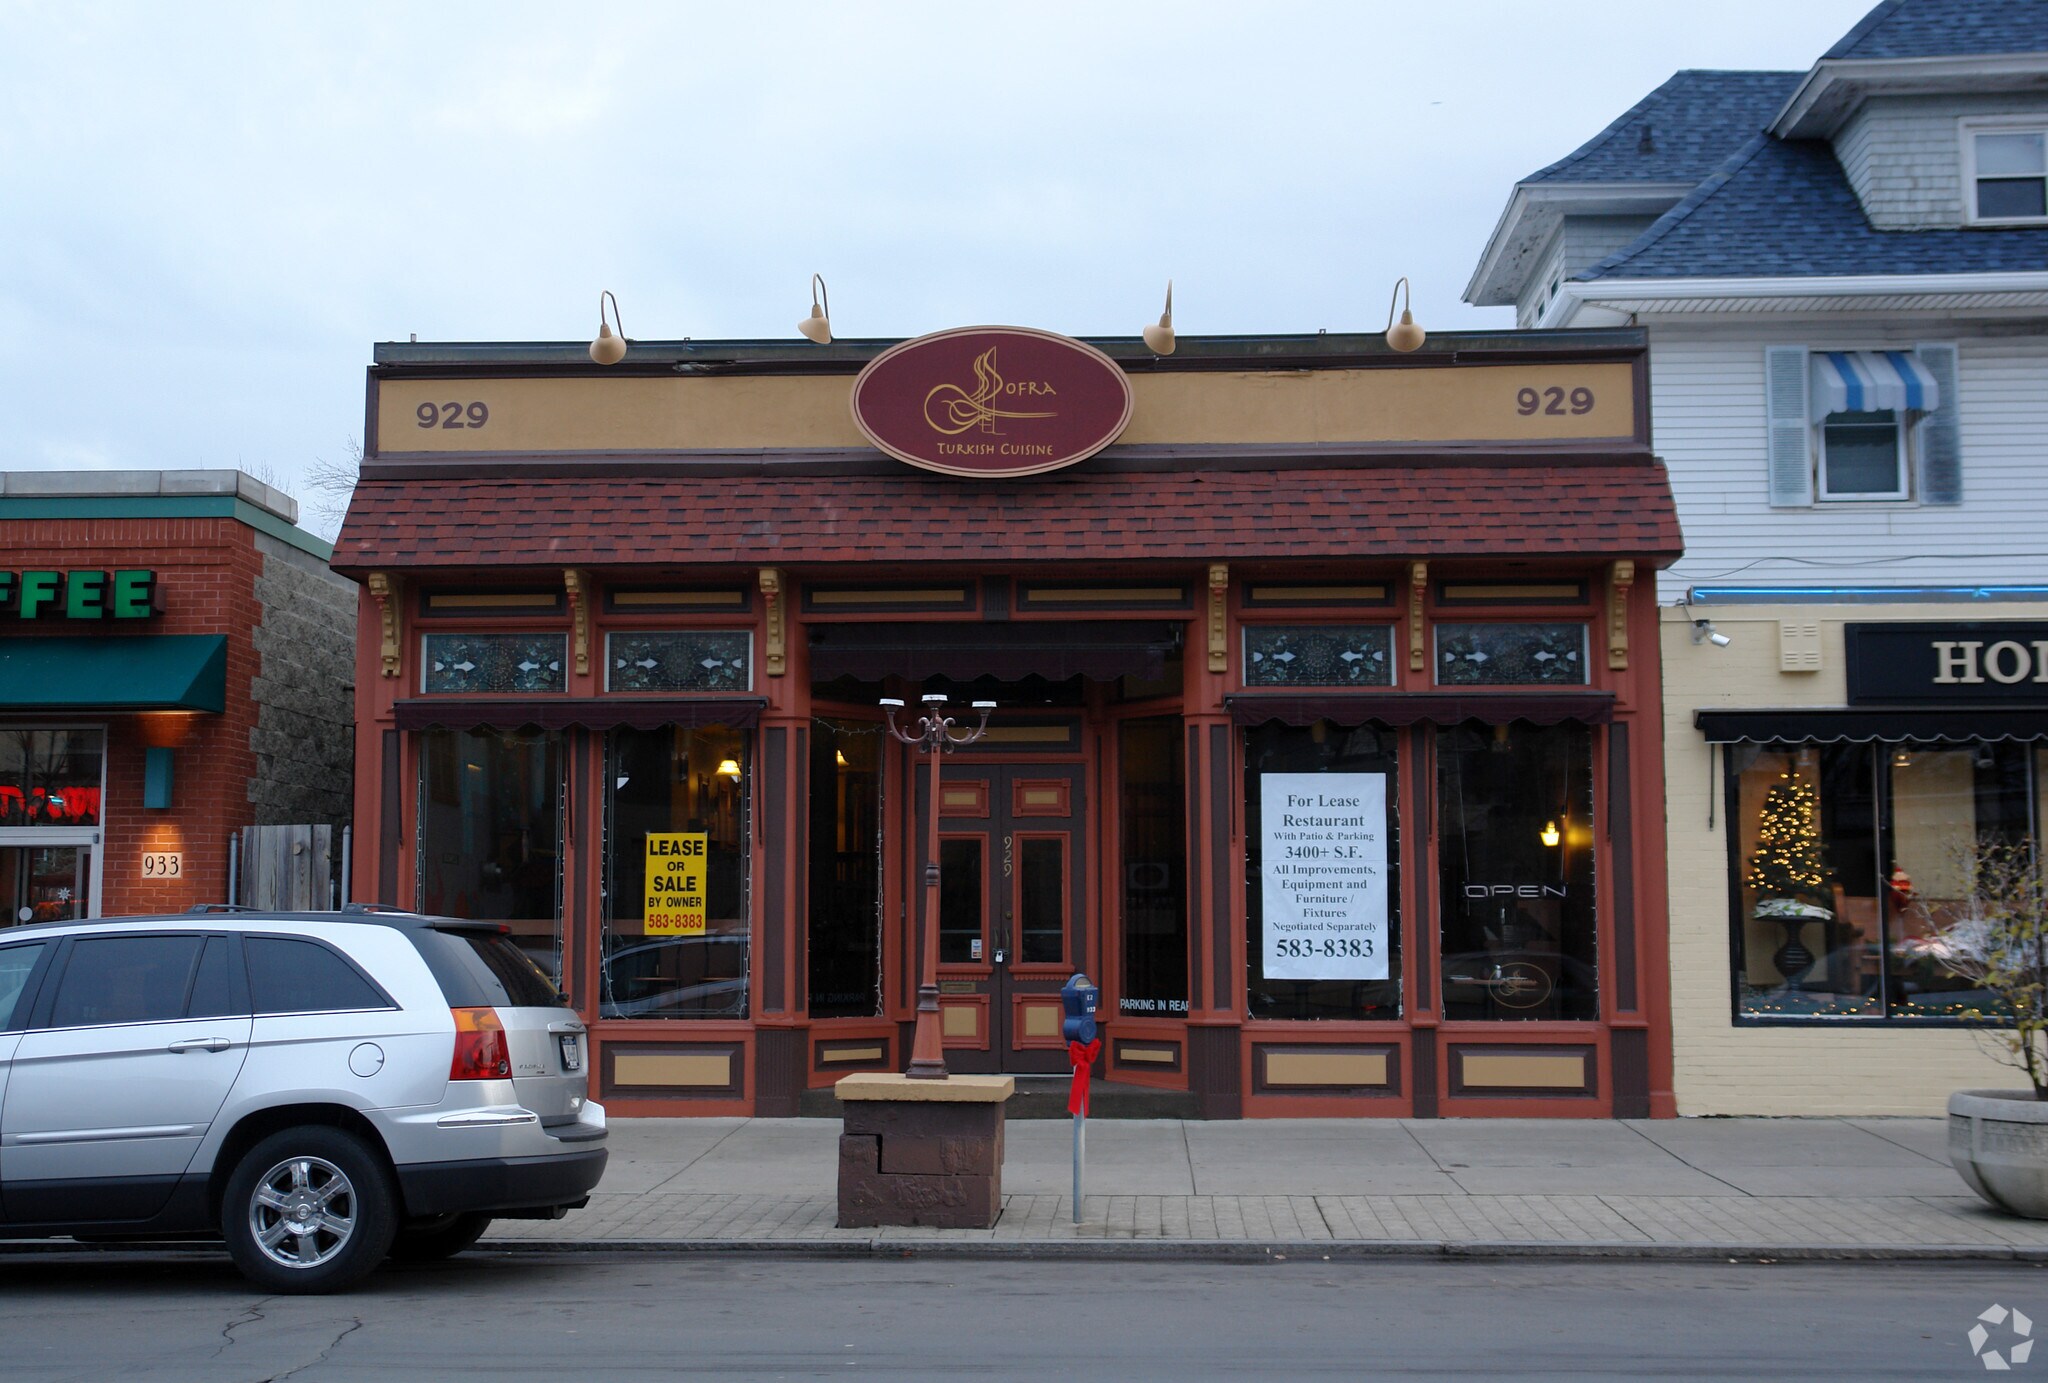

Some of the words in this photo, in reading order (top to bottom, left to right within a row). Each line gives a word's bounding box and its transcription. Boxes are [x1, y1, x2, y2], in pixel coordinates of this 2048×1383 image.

[1517, 386, 1595, 416] 929
[416, 401, 489, 429] 929
[937, 443, 995, 456] TURKISH
[1001, 443, 1054, 456] CUISINE
[1287, 794, 1314, 808] For
[1318, 794, 1360, 808] Lease
[1282, 814, 1365, 827] Restaurant
[1273, 832, 1297, 841] With
[1300, 832, 1323, 841] Patio
[1326, 832, 1334, 841] &
[1337, 832, 1375, 842] Parking
[649, 839, 704, 856] LEASE
[1285, 845, 1330, 859] 3400+
[1334, 845, 1363, 859] S.F.
[145, 855, 179, 876] 933
[667, 861, 685, 872] OR
[1273, 864, 1289, 875] All
[1293, 864, 1377, 877] Improvements,
[653, 875, 697, 892] SALE
[1281, 879, 1343, 892] Equipment
[1346, 879, 1368, 890] and
[1464, 884, 1566, 898] OPEN
[648, 896, 662, 908] BY
[666, 896, 702, 908] OWNER
[1295, 893, 1348, 904] Furniture
[1303, 907, 1347, 918] Fixtures
[648, 913, 703, 929] 583-8383
[1273, 921, 1324, 932] Negotiated
[1326, 921, 1378, 933] Separately
[1276, 938, 1374, 958] 583-8383
[1120, 998, 1155, 1011] PARKING
[1157, 999, 1167, 1011] IN
